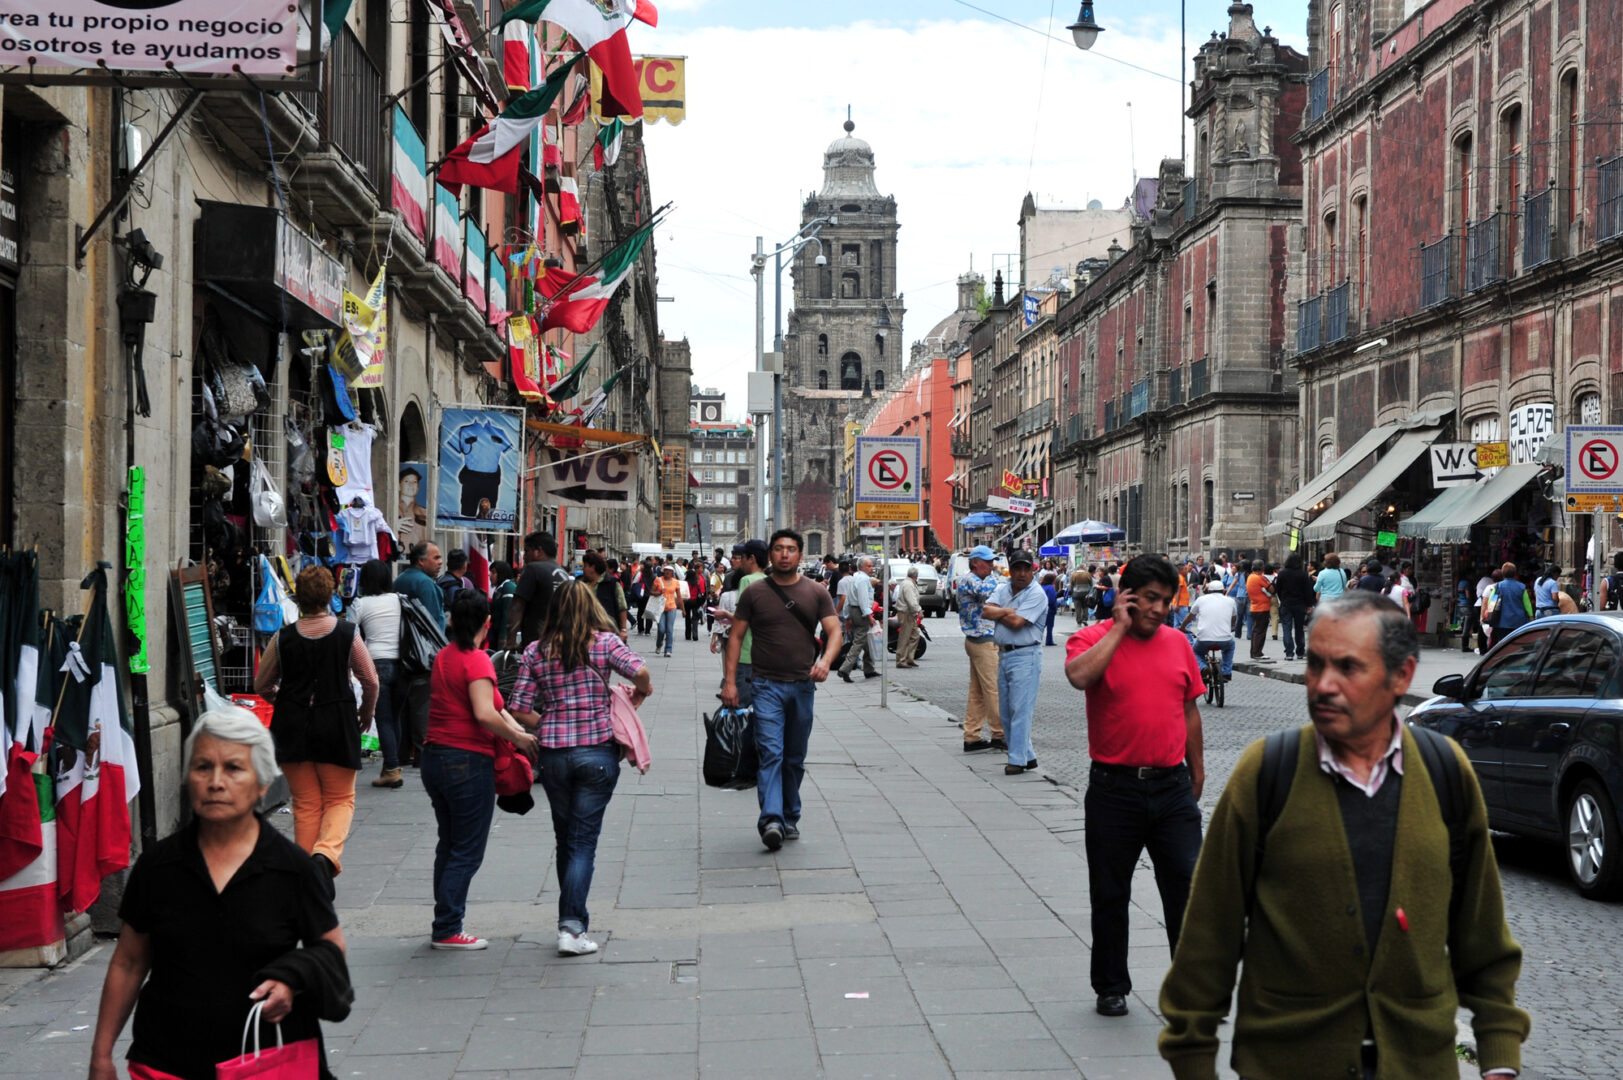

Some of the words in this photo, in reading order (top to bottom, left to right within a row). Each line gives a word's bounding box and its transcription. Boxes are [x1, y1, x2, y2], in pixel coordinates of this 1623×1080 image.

[0, 13, 39, 27] rea
[48, 12, 73, 27] tu
[83, 14, 169, 34] propio
[178, 18, 283, 37] negocio
[1, 37, 103, 54] osotros
[112, 39, 136, 55] te
[144, 42, 281, 60] ayudamos
[1510, 407, 1554, 437] PLAZA
[547, 449, 630, 484] WC
[1004, 471, 1024, 491] WC
